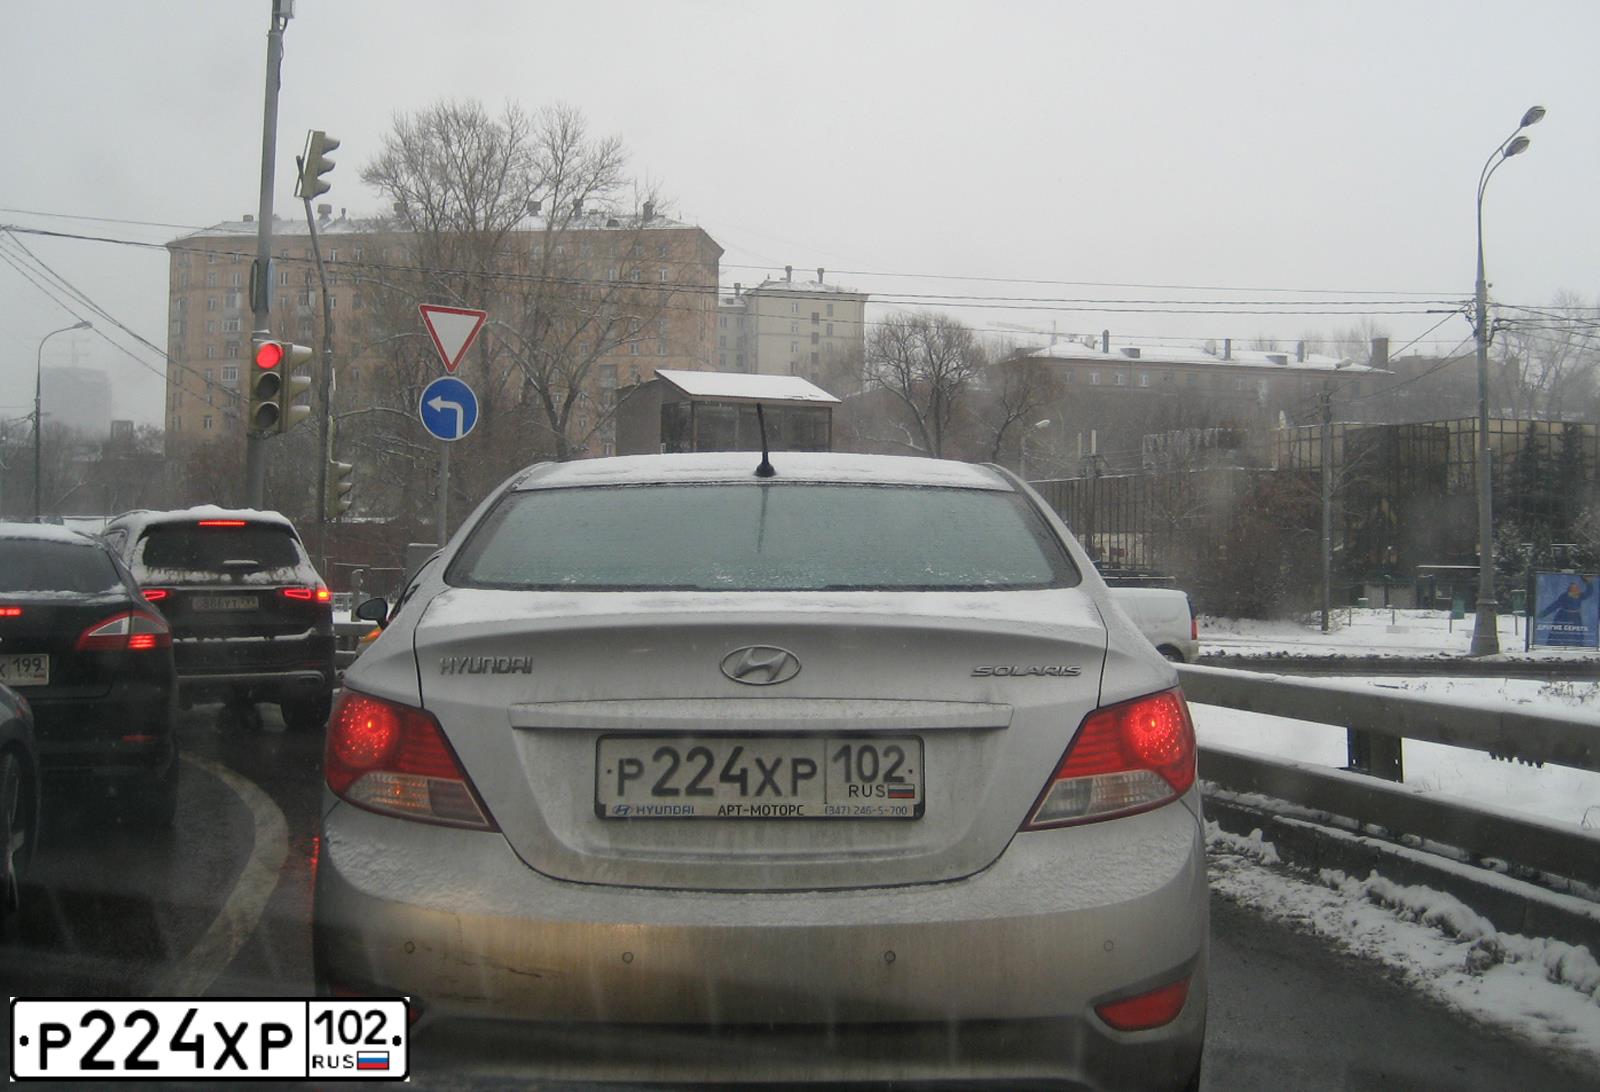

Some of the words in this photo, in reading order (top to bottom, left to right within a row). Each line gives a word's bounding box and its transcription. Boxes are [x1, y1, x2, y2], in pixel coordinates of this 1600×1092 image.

[12, 657, 41, 672] 199
[440, 656, 532, 675] HYUNDAI
[970, 665, 1081, 677] SOLARIS
[832, 744, 906, 783] 102
[849, 784, 886, 798] RUS
[636, 804, 695, 815] HYUNDAI
[717, 804, 804, 816] АРТ-МОТОРС
